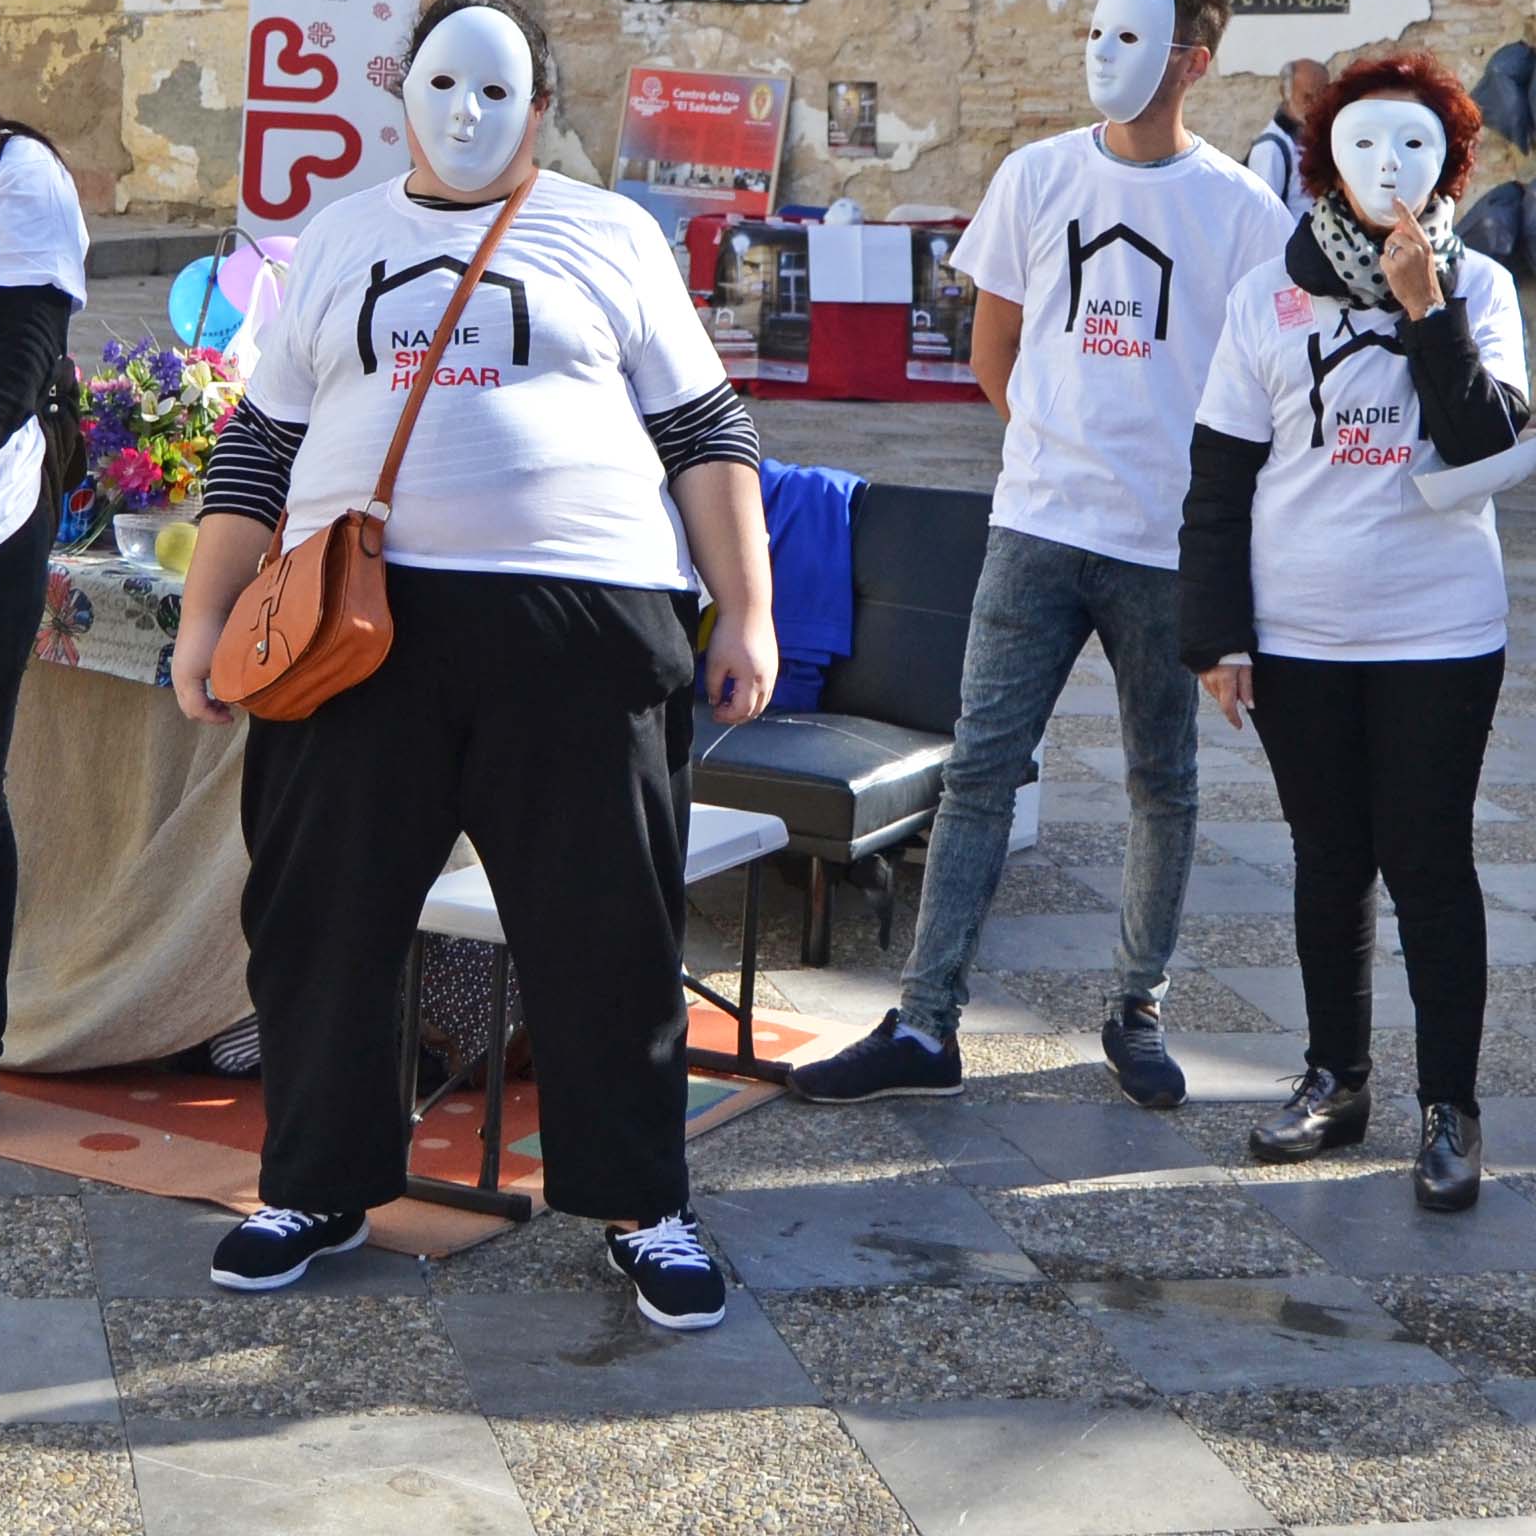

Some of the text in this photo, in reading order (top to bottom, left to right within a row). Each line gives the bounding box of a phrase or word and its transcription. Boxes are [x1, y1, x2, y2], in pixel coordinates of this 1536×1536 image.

[1086, 299, 1143, 318] NADIE
[1084, 317, 1118, 336] SIN
[392, 327, 480, 349] NAIE
[1082, 337, 1152, 360] HOGAR
[1335, 406, 1401, 425] NADIE
[1337, 427, 1370, 446] SIN
[1331, 446, 1412, 466] HOGAR
